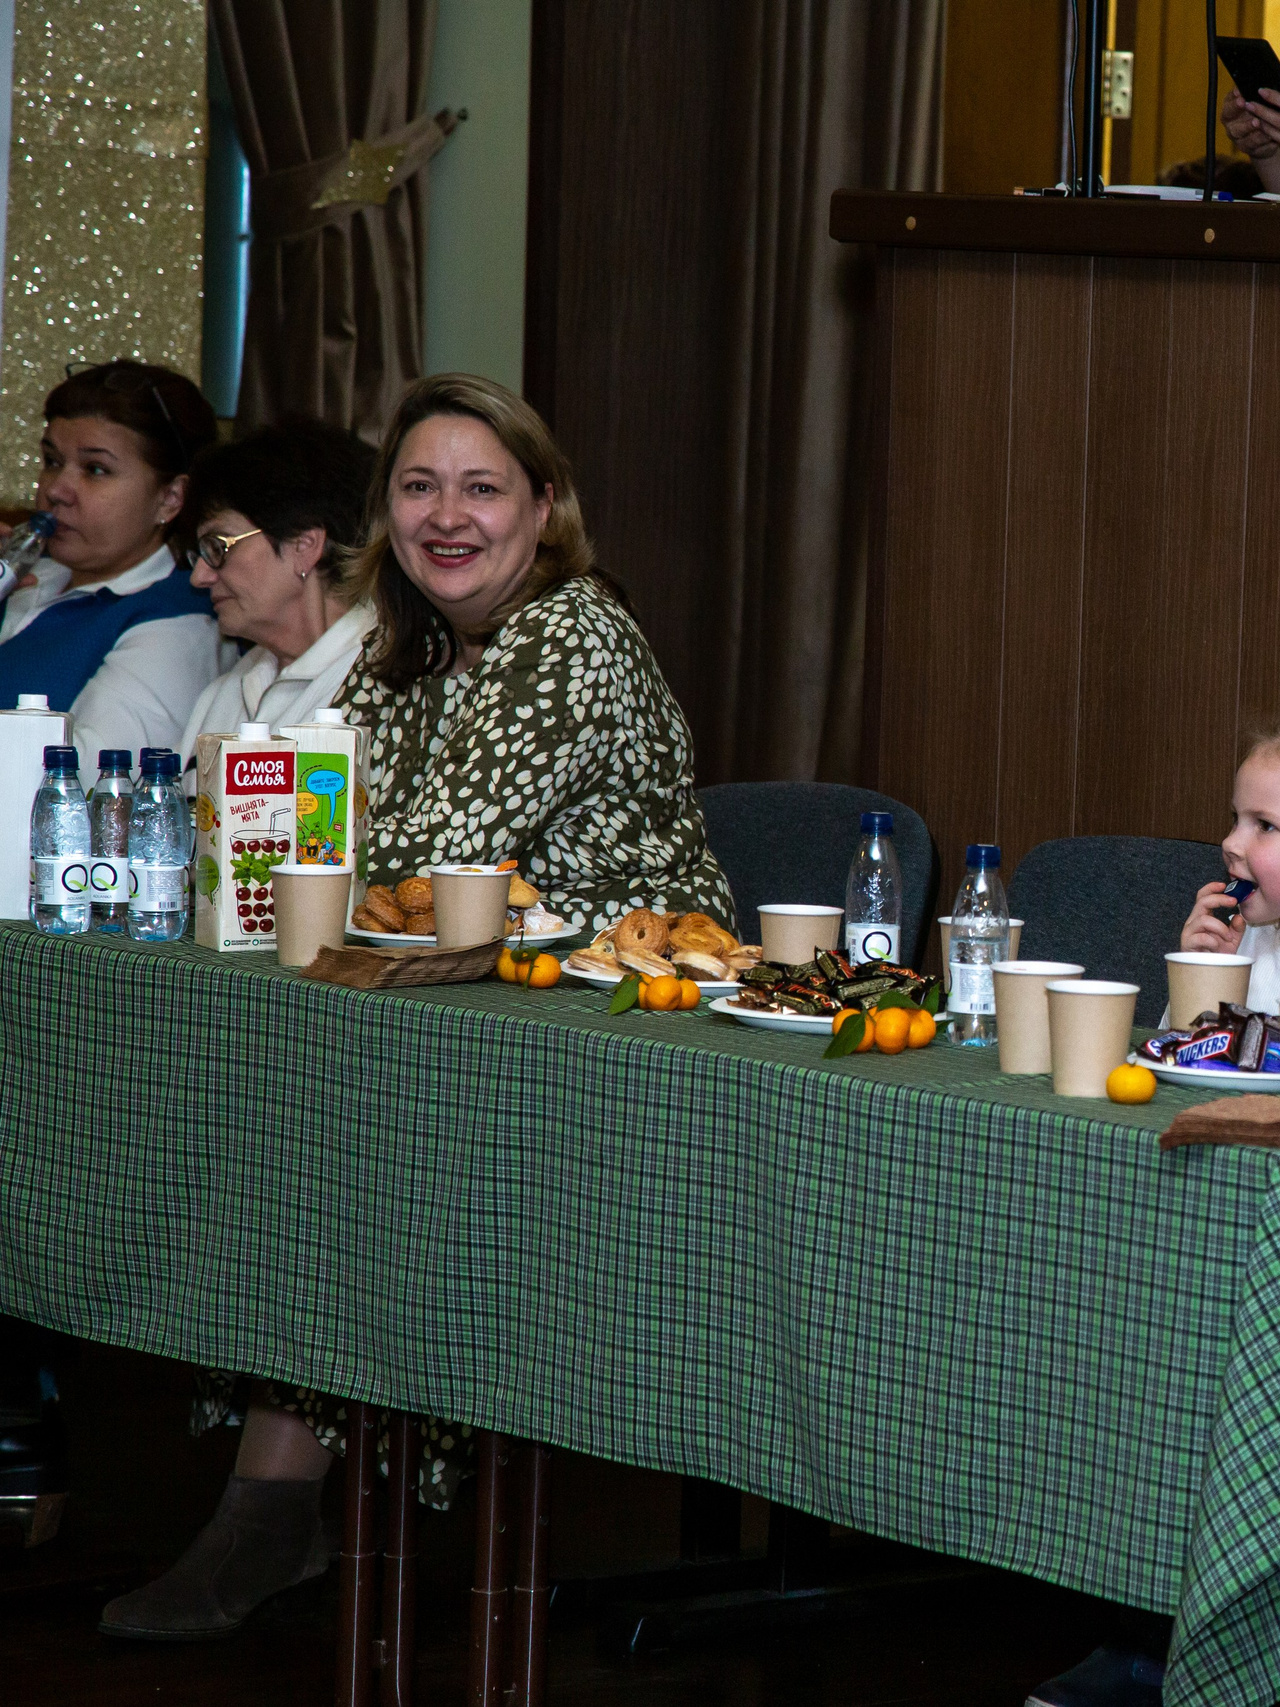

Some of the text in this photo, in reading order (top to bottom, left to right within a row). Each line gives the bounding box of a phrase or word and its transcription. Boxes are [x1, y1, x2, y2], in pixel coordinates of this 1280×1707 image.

[233, 760, 287, 787] Семья
[250, 760, 284, 774] МОЯ
[241, 811, 260, 823] МЯТА
[862, 931, 893, 961] Q
[1176, 1035, 1229, 1063] NICKERS
